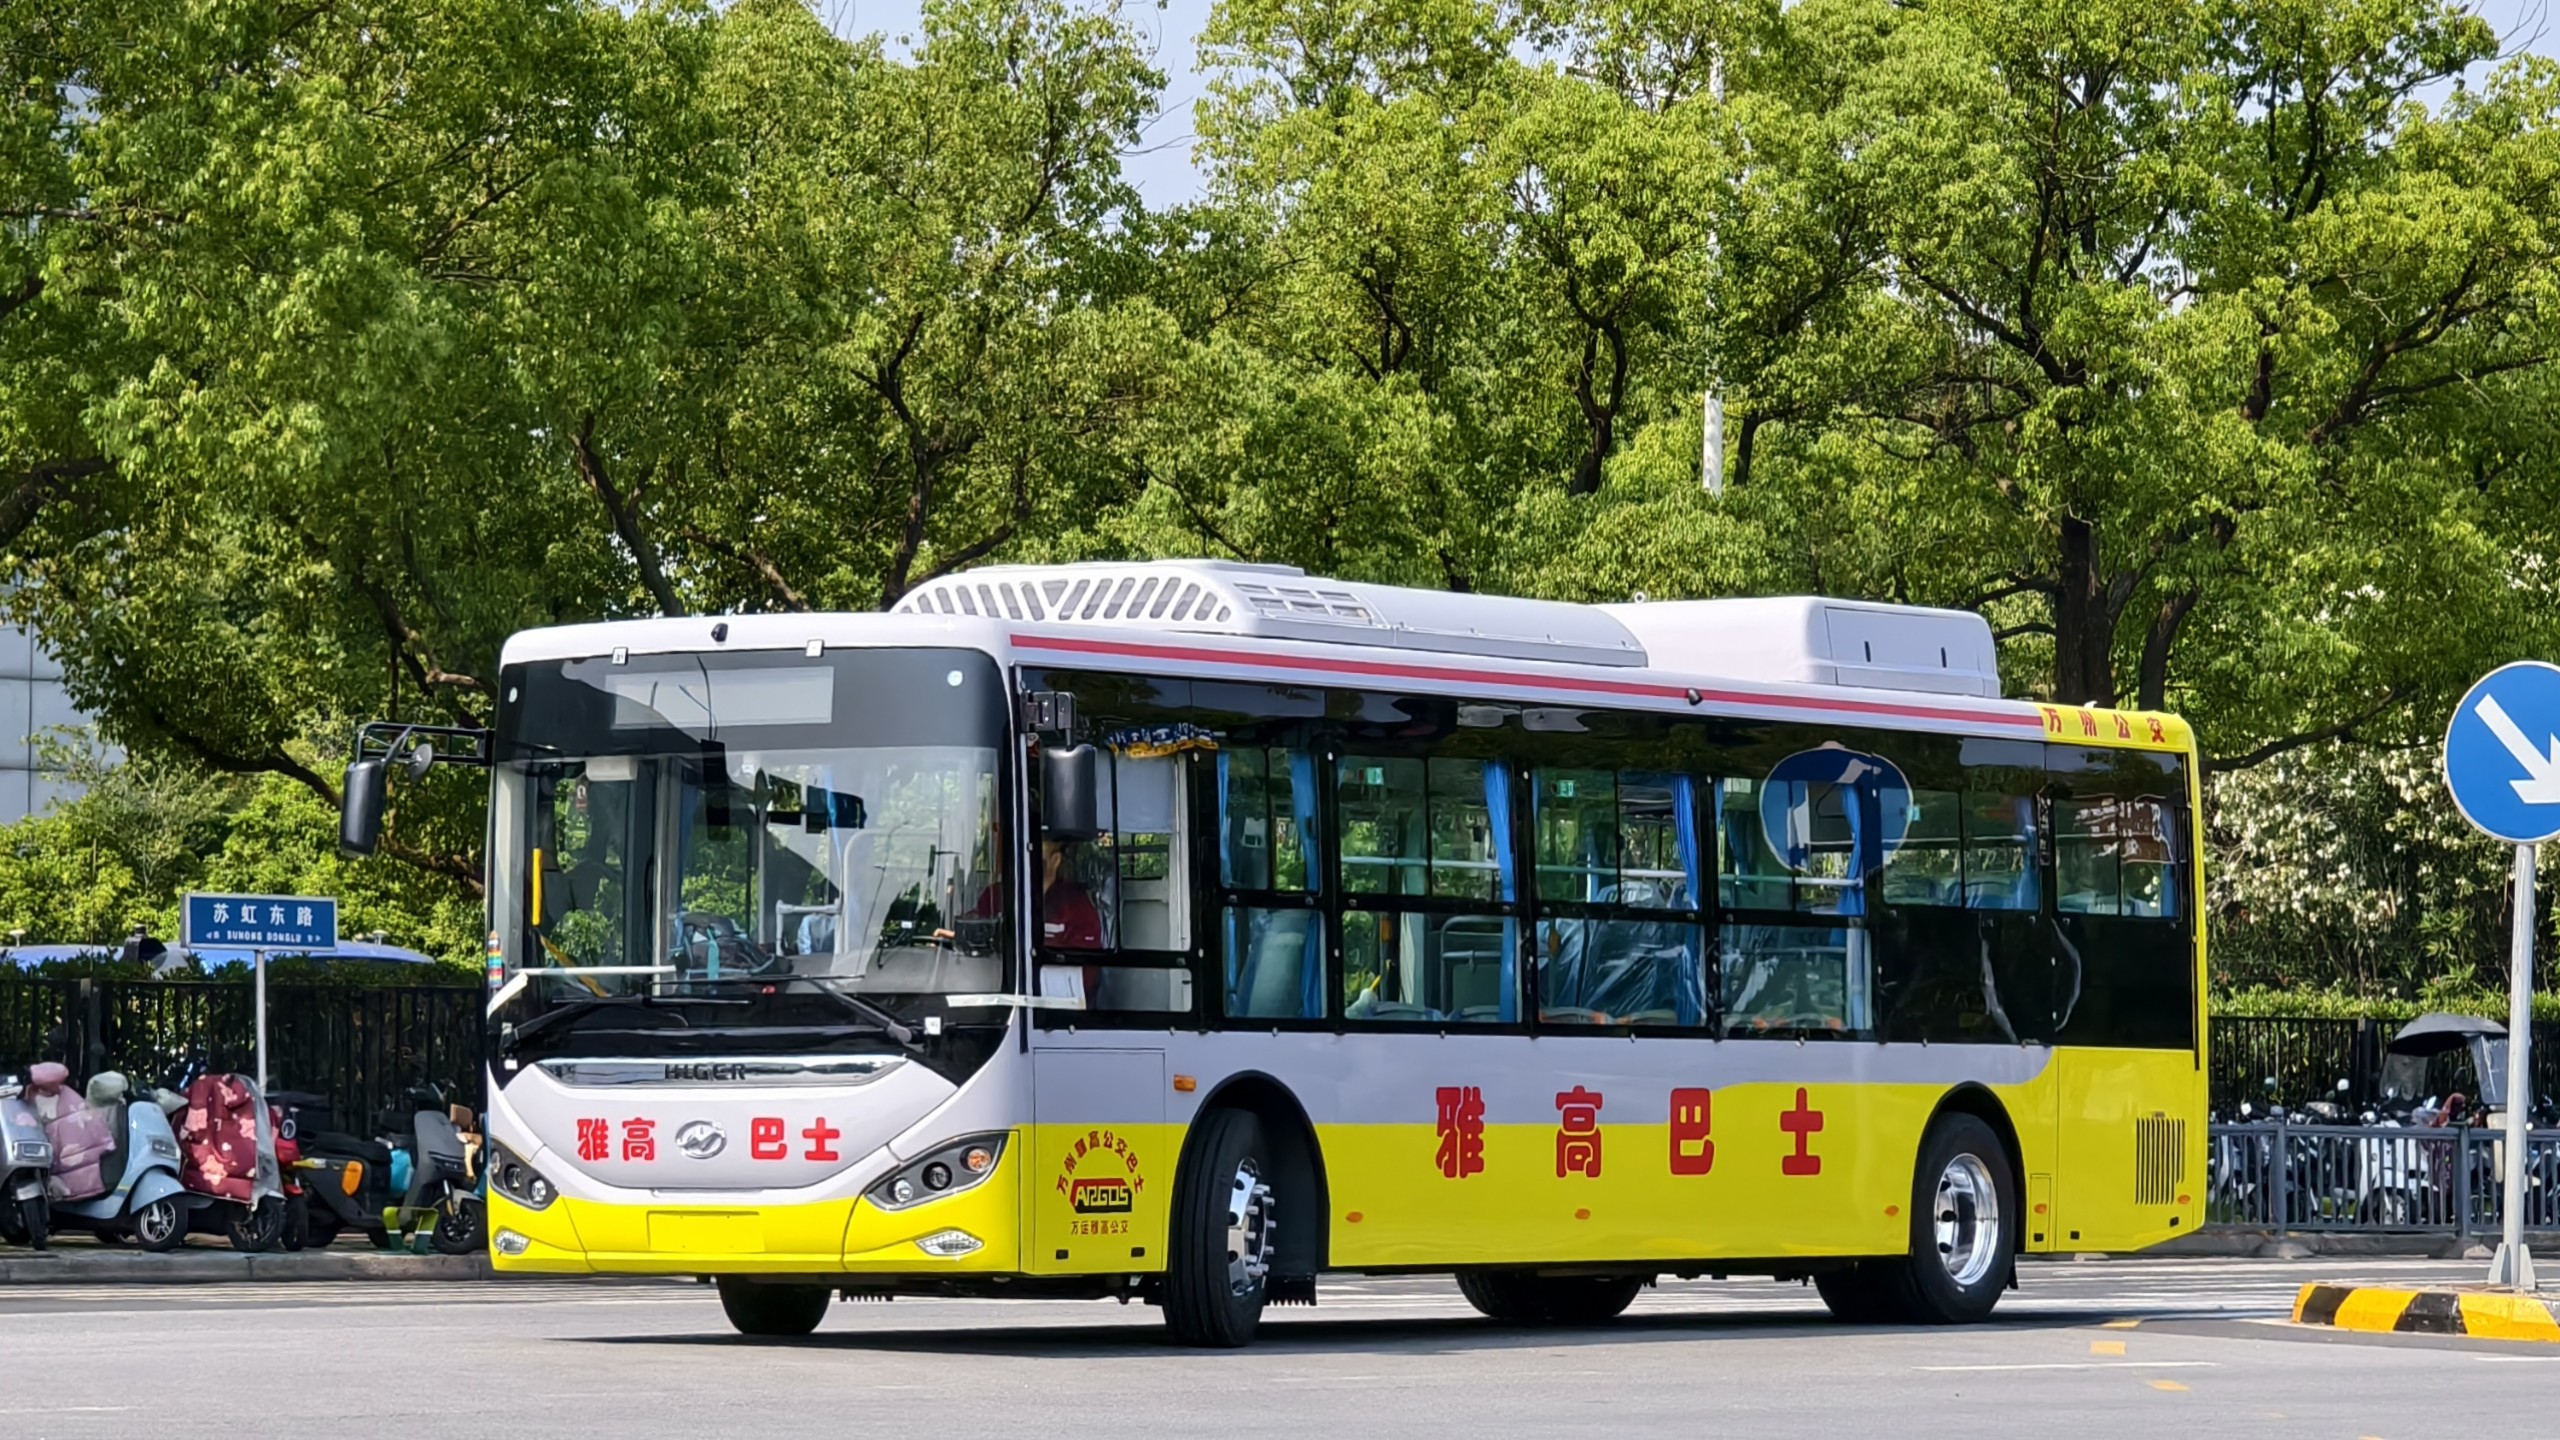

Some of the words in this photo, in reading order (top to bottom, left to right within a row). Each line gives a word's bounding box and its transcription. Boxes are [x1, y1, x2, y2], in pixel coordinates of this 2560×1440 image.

[2042, 707, 2166, 744] 万州公交
[213, 902, 313, 927] 苏虹东路
[664, 1062, 746, 1081] HIGER
[577, 1116, 655, 1161] 雅高
[750, 1116, 840, 1161] 巴士
[1435, 1085, 1824, 1178] 雅高巴士
